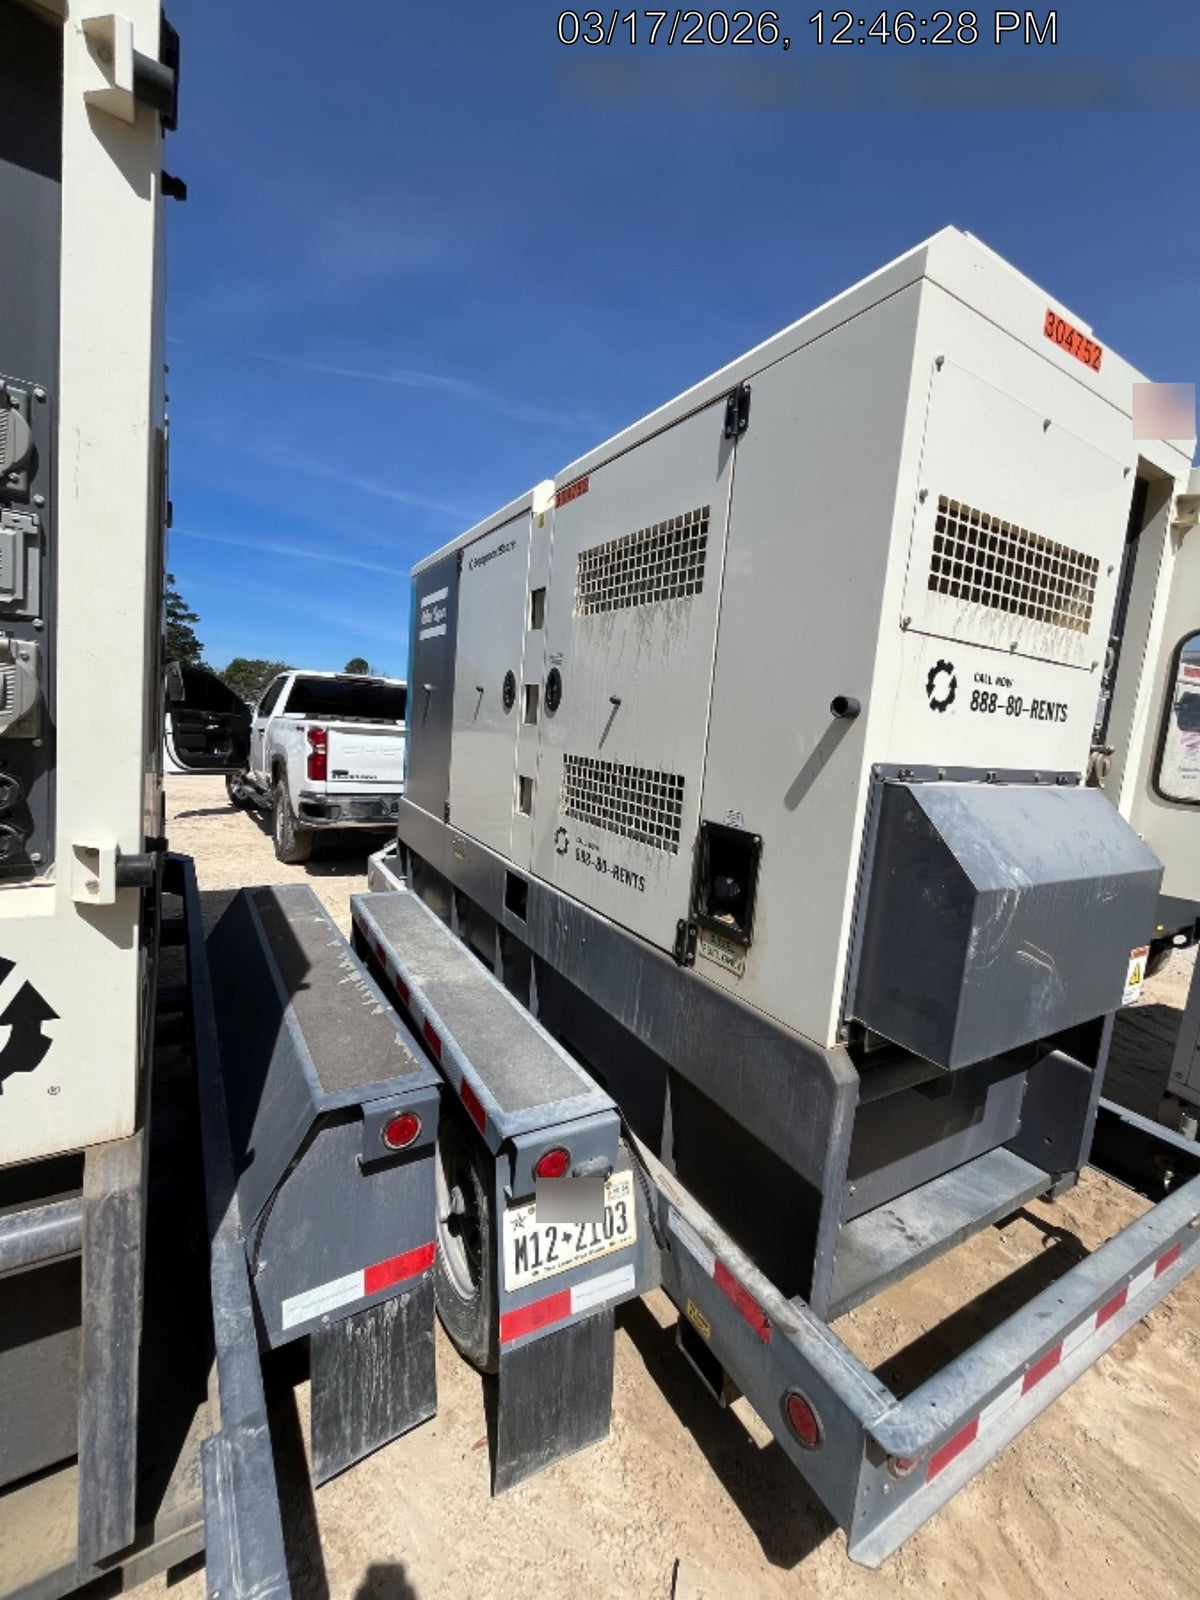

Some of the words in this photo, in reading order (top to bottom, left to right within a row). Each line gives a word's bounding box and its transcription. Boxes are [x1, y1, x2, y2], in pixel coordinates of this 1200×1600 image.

[1045, 311, 1103, 373] 304752
[969, 689, 1068, 723] 888-80-RENTS
[514, 1225, 559, 1275] M12
